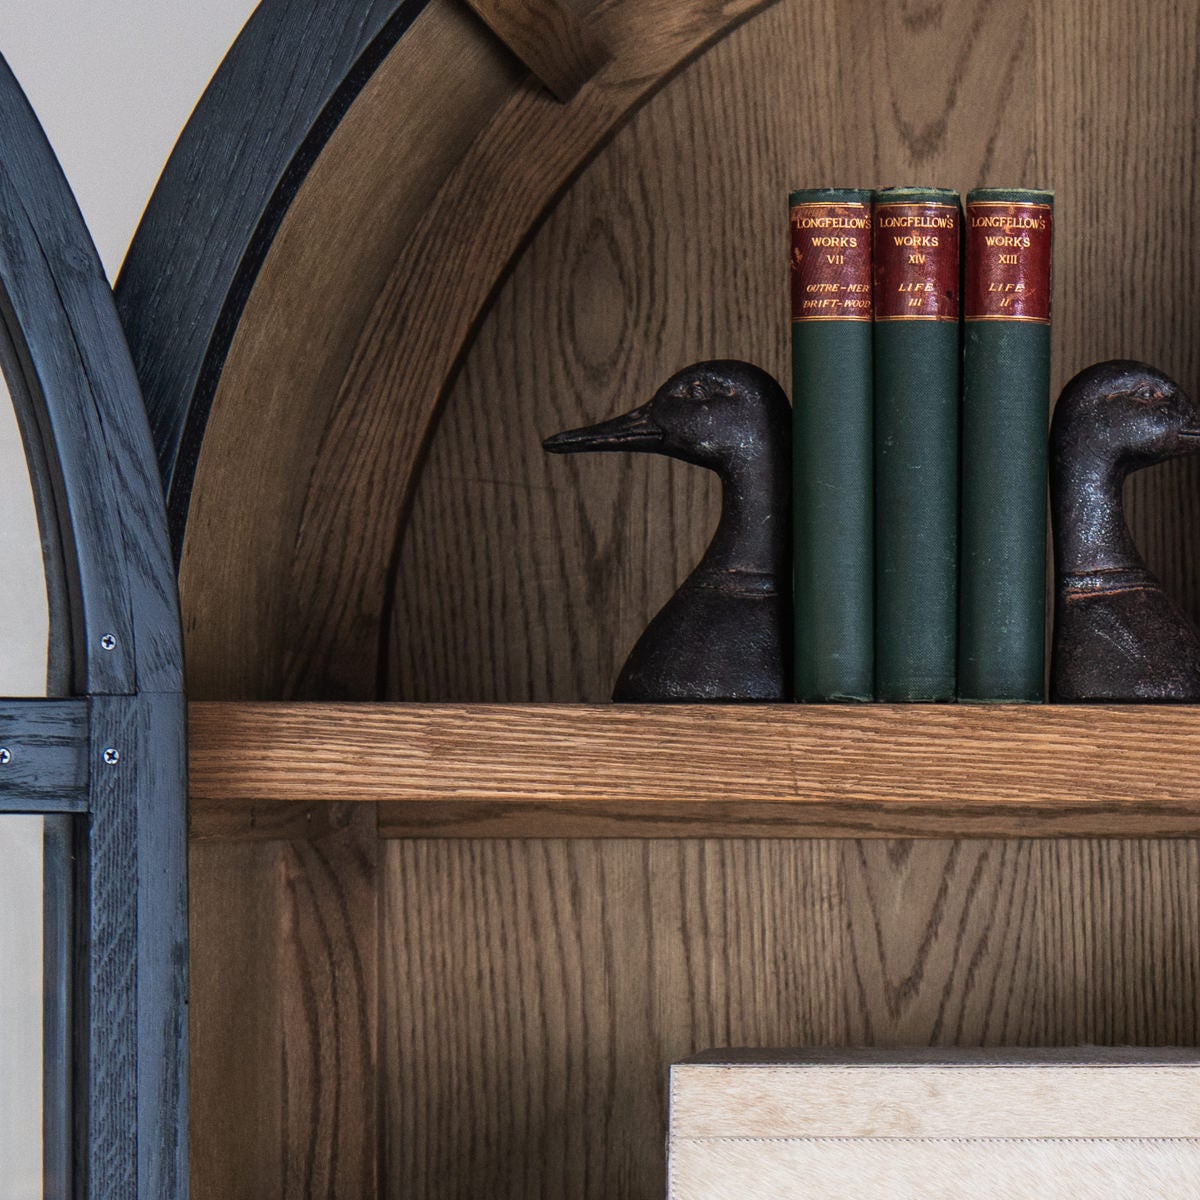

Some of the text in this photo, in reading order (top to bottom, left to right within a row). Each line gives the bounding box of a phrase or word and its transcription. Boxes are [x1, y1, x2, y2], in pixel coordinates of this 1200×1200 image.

[797, 215, 872, 229] LONGFELLOW'S
[879, 214, 954, 229] LONGFELLOW'S
[971, 215, 1046, 229] LONGFELLOW'S
[811, 236, 858, 247] WORKS
[894, 236, 939, 247] WORKS
[985, 236, 1031, 247] WORKS
[826, 255, 844, 265] VII
[908, 254, 926, 264] XIV
[998, 254, 1018, 265] XIII
[806, 283, 871, 293] OUTRE-MER
[898, 283, 934, 292] LIFE
[988, 283, 1025, 292] LIFE
[908, 298, 922, 307] III
[1000, 298, 1011, 307] II
